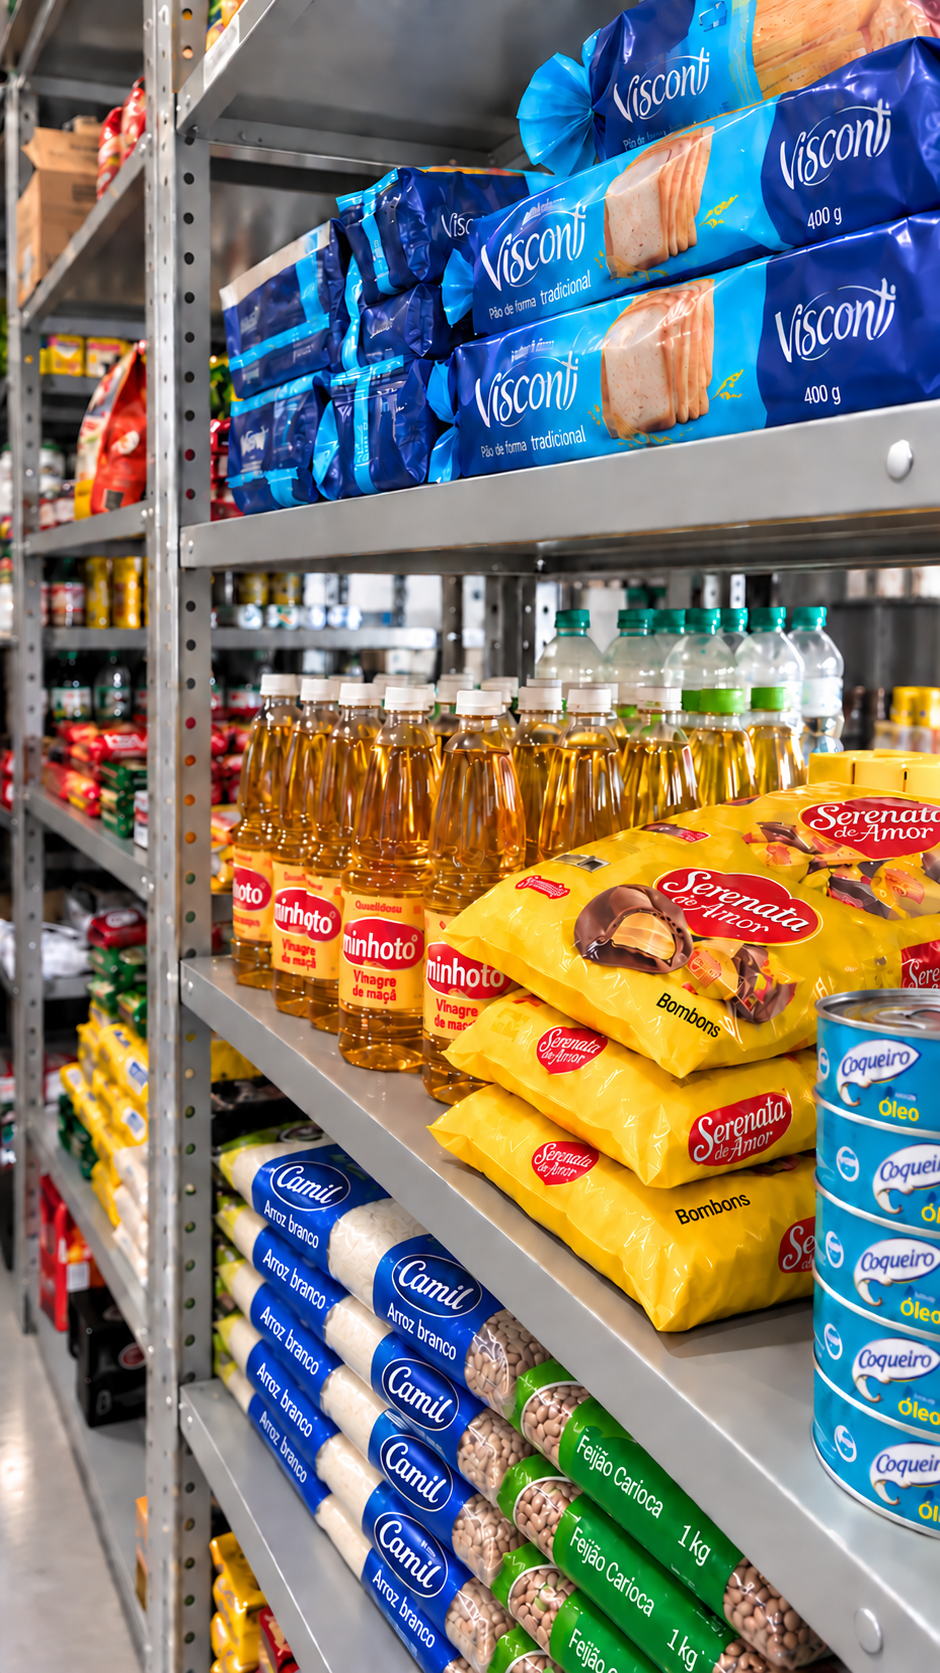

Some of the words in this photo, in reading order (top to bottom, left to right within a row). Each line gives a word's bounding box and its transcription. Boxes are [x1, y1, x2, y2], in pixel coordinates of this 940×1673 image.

[613, 47, 710, 124] Visconti
[779, 99, 892, 190] Visconti
[807, 208, 830, 230] 400
[832, 208, 842, 226] g
[481, 203, 587, 291] Visconti
[504, 302, 514, 316] de
[514, 297, 537, 313] forma
[540, 269, 592, 305] tradicional
[775, 277, 897, 363] Visconti
[475, 349, 579, 429] Visconti
[804, 386, 828, 405] 400
[830, 388, 842, 406] g
[495, 442, 505, 456] de
[505, 440, 527, 454] forma
[531, 424, 586, 451] tradicional
[834, 825, 858, 838] de
[854, 824, 934, 842] Amor
[662, 871, 809, 932] Serenata
[683, 903, 769, 933] Amor
[344, 930, 416, 960] minhoto
[352, 984, 364, 997] de
[427, 955, 504, 988] minhoto
[434, 1014, 445, 1028] de
[436, 998, 478, 1019] Vinagre
[656, 992, 721, 1038] Bombons
[539, 1028, 600, 1054] Serenata
[548, 1049, 585, 1065] Amor
[842, 1049, 910, 1076] Coqueiro
[694, 1096, 786, 1162] Serenata
[879, 1097, 919, 1122] Óleo
[714, 1144, 729, 1160] de
[727, 1131, 773, 1162] Amor
[276, 1165, 343, 1204] Camil
[264, 1200, 287, 1227] Arroz
[288, 1213, 319, 1249] branco
[674, 1193, 751, 1225] Bombons
[262, 1249, 289, 1281] Arroz
[290, 1267, 326, 1310] branco
[861, 1249, 935, 1275] Coqueiro
[398, 1260, 474, 1310] Camil
[387, 1303, 415, 1333] Arroz
[418, 1319, 457, 1361] branco
[900, 1297, 940, 1324] Óleo
[260, 1306, 285, 1341] Arroz
[286, 1329, 320, 1375] branco
[858, 1350, 932, 1373] Coqueiro
[256, 1362, 281, 1400] Arroz
[280, 1389, 313, 1438] branco
[388, 1366, 452, 1423] Camil
[898, 1397, 940, 1425] Óleo
[259, 1411, 281, 1445] Arroz
[280, 1435, 307, 1483] branco
[385, 1442, 447, 1503] Camil
[576, 1435, 613, 1477] Feijão
[613, 1466, 664, 1519] Carioca
[677, 1525, 692, 1548] 1
[689, 1532, 711, 1567] kg
[379, 1520, 441, 1589] Camil
[372, 1569, 399, 1609] Arroz
[399, 1596, 435, 1649] branco
[569, 1526, 605, 1571] Feijão
[606, 1562, 655, 1617] Carioca
[667, 1629, 679, 1651] 1
[678, 1636, 698, 1672] kg
[568, 1628, 605, 1673] Feijão
